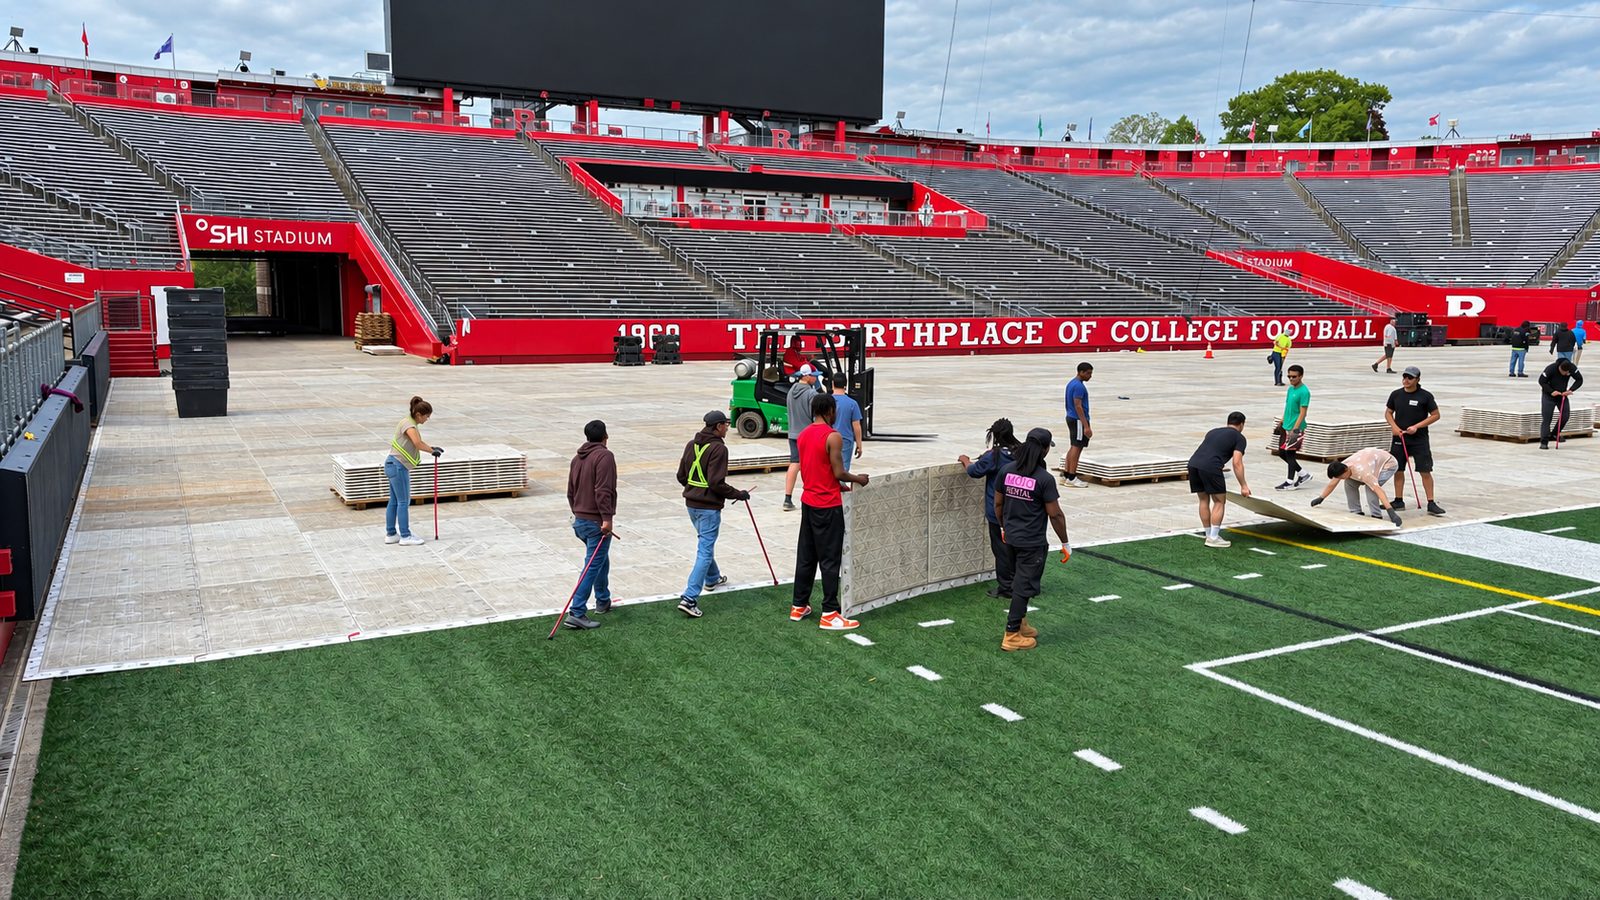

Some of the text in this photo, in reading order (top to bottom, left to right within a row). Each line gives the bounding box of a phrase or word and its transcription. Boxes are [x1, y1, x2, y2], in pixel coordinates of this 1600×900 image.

[771, 128, 793, 149] R
[209, 225, 332, 245] SHI STADIUM
[1247, 257, 1293, 268] STADIUM
[1446, 295, 1486, 317] R
[824, 321, 1043, 348] BRTHPLACE
[1058, 321, 1097, 344] OF
[1110, 320, 1238, 343] COLLEGE
[1250, 319, 1377, 341] FOOTBALL
[1006, 474, 1035, 489] MOJO
[1006, 486, 1031, 498] RENTAL
